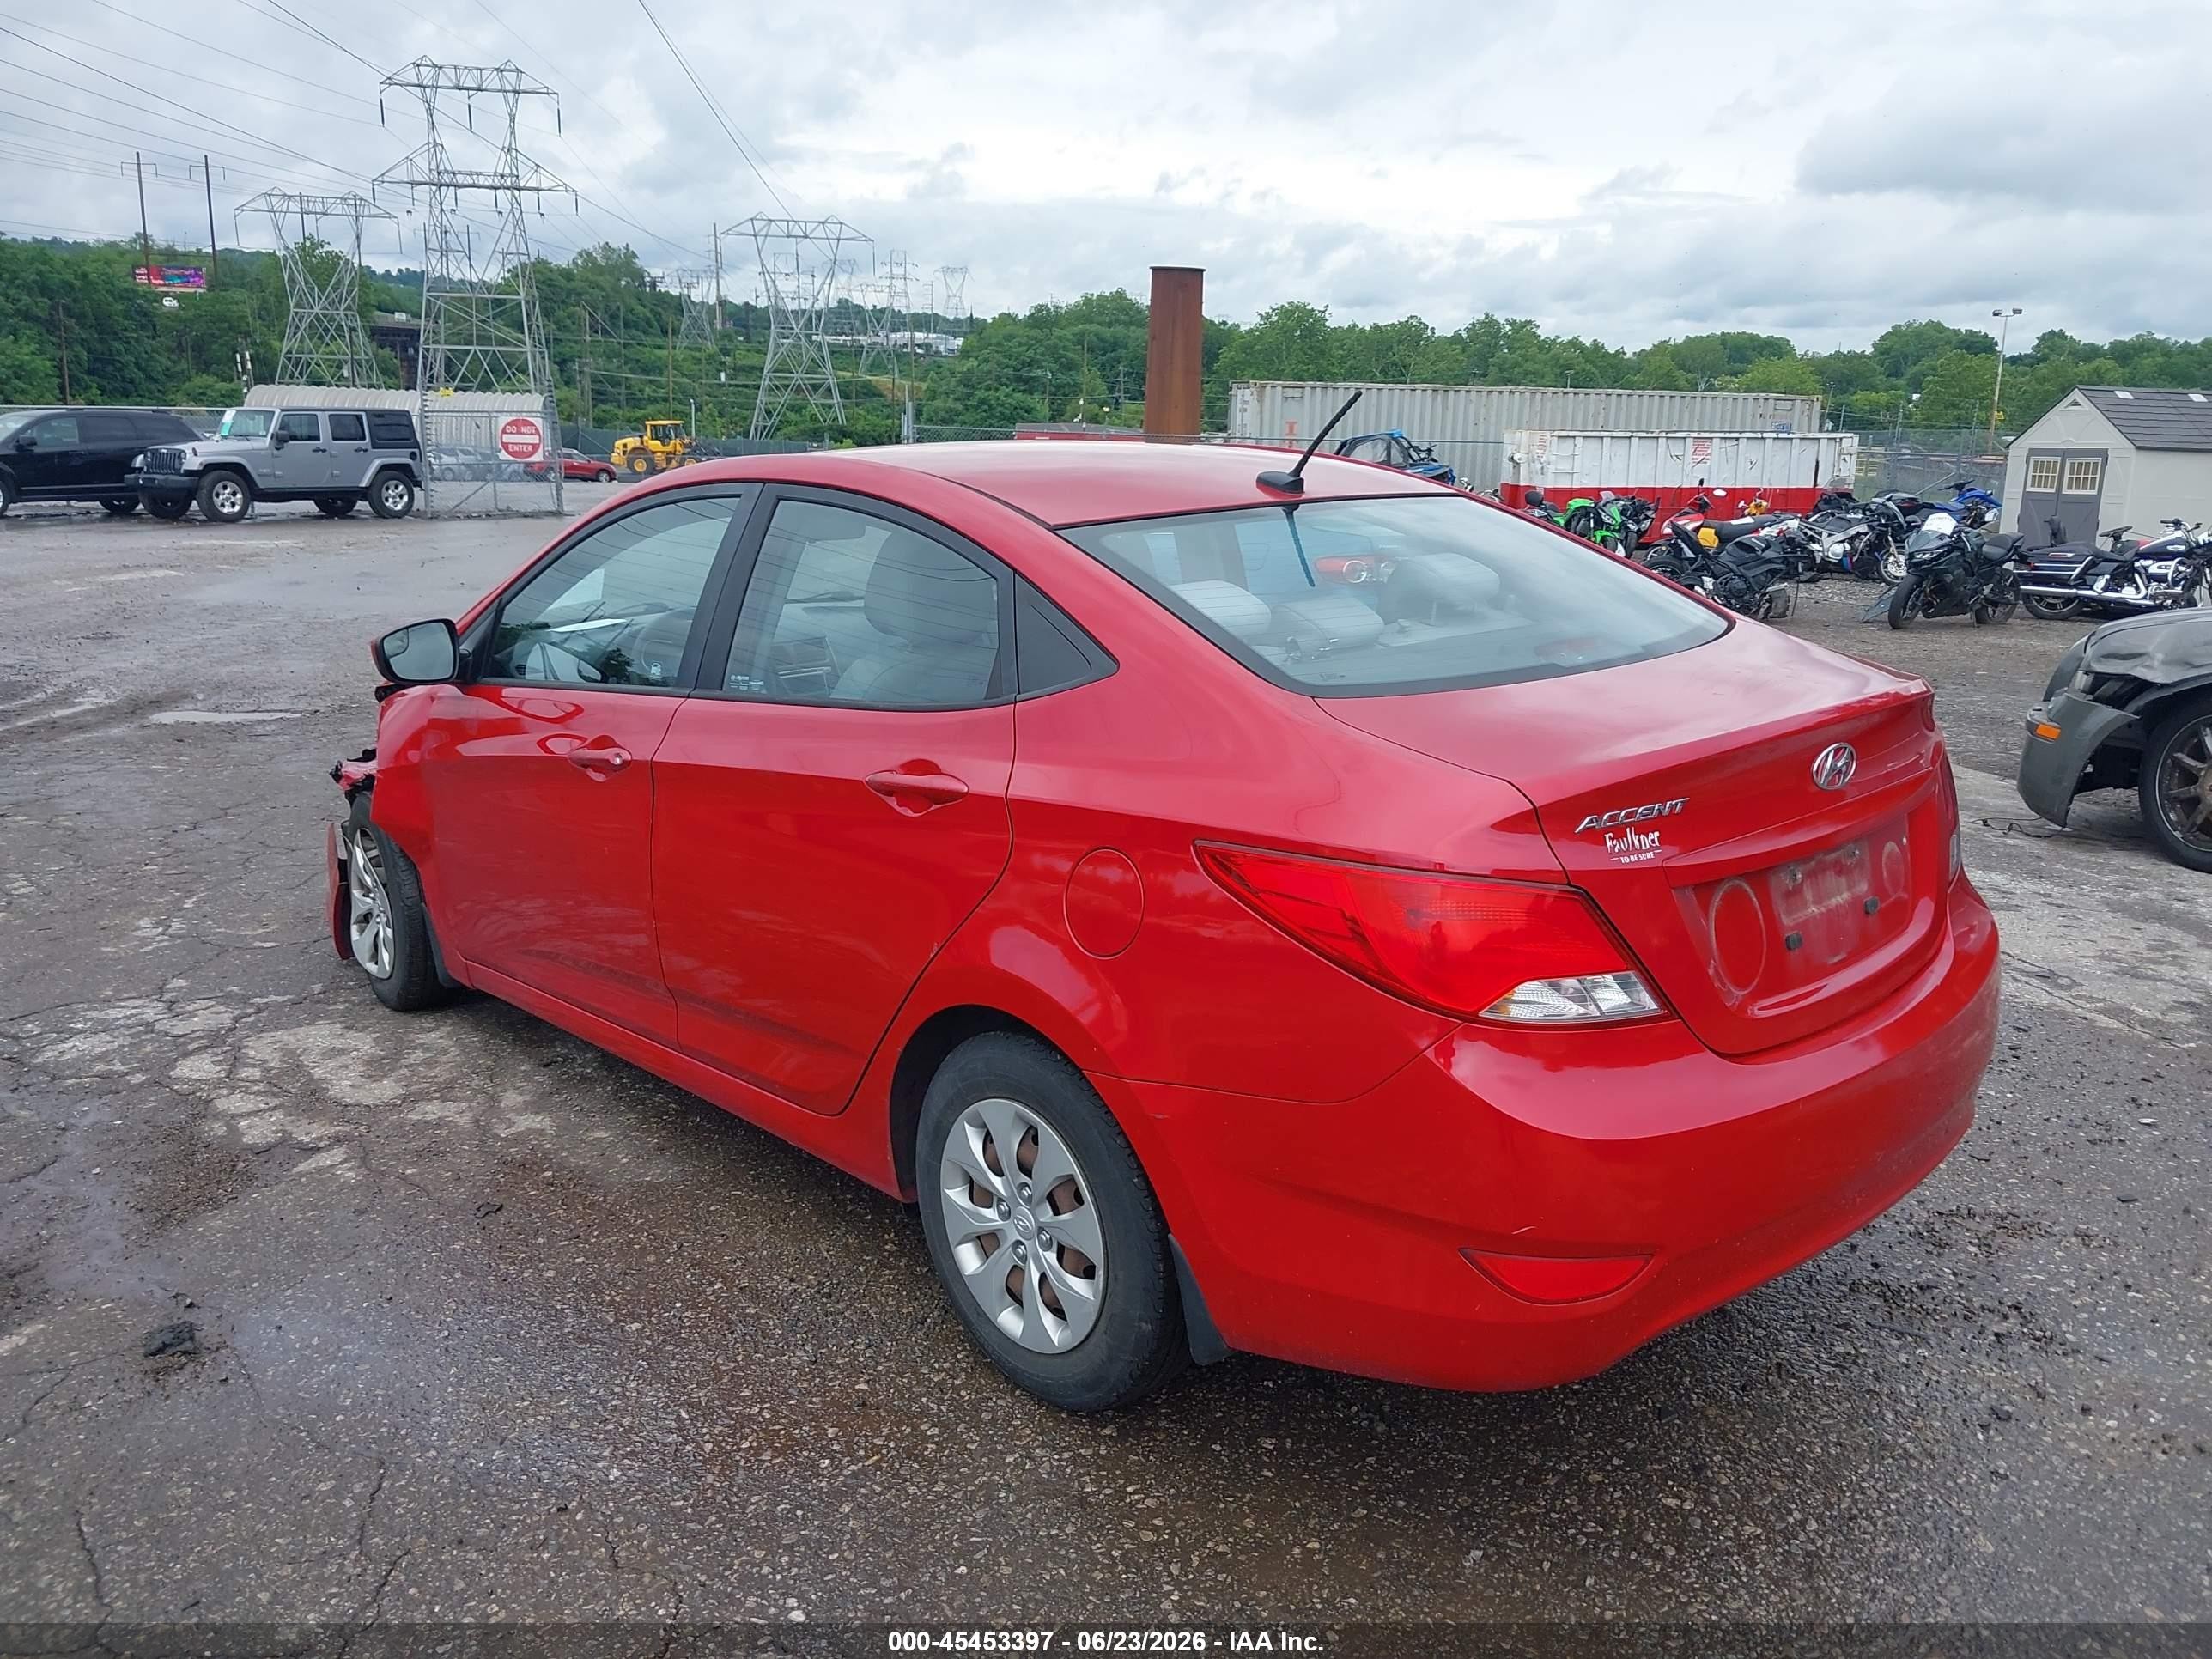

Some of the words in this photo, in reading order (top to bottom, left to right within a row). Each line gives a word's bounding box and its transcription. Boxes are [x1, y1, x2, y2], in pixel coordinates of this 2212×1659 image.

[508, 444, 533, 453] ENTER
[1574, 797, 1691, 834] ACCENT
[1604, 827, 1661, 854] Faulkner
[1638, 852, 1655, 860] SURE
